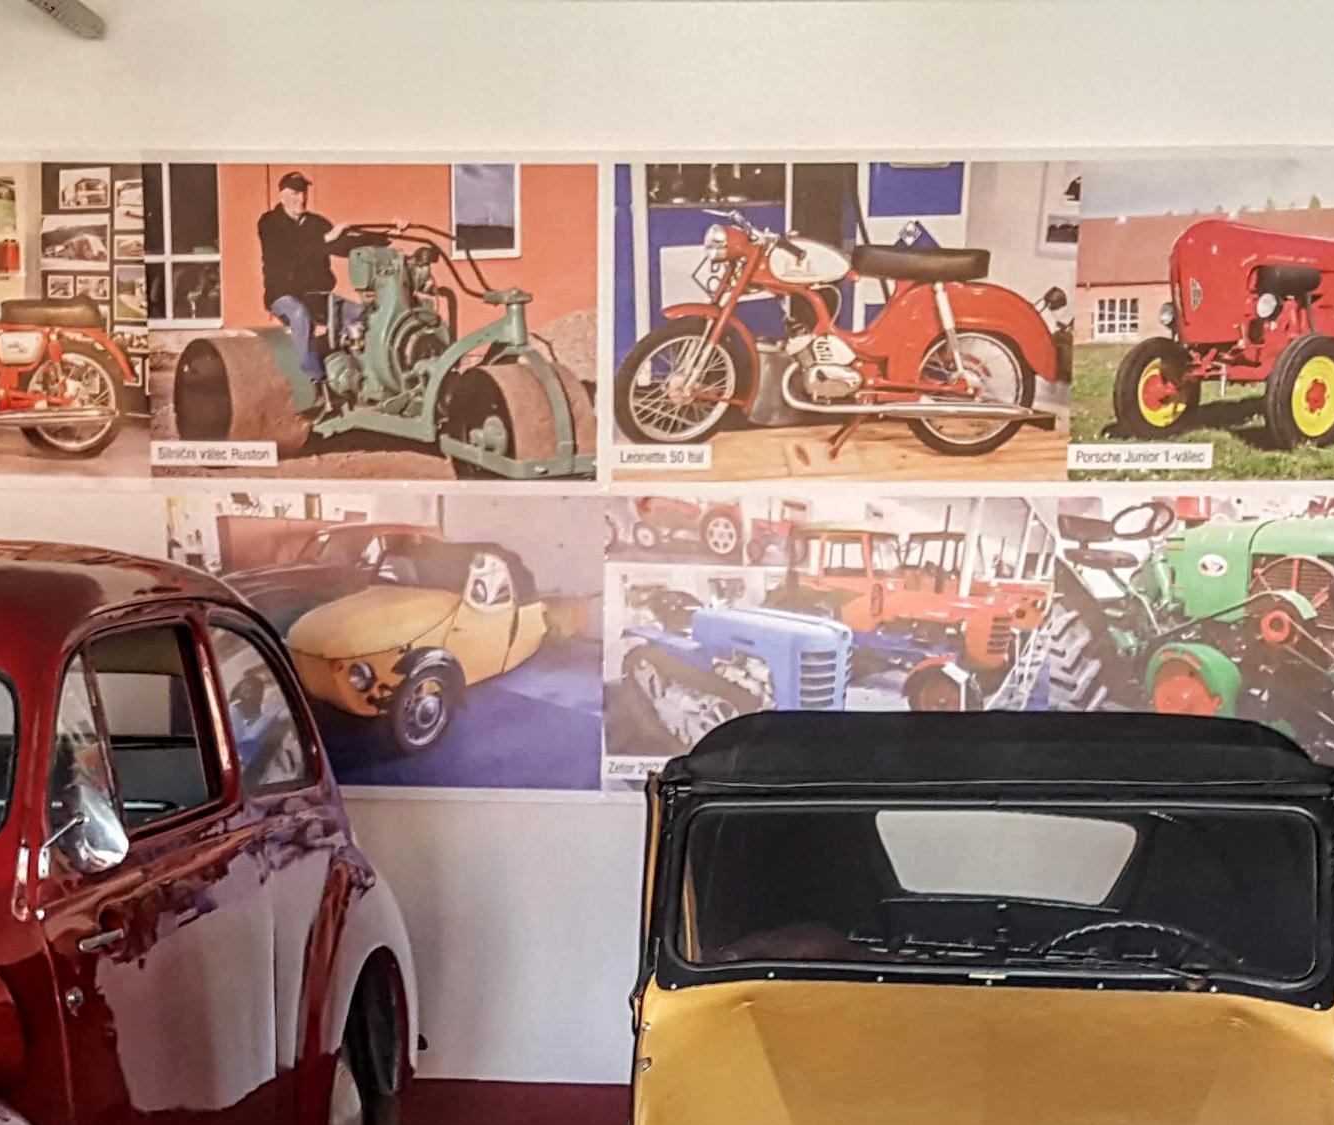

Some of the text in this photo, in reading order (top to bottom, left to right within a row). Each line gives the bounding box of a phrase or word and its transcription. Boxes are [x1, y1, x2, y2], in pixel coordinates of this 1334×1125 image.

[669, 450, 685, 463] 50
[1076, 450, 1121, 463] Porsche
[1124, 450, 1160, 463] Junior
